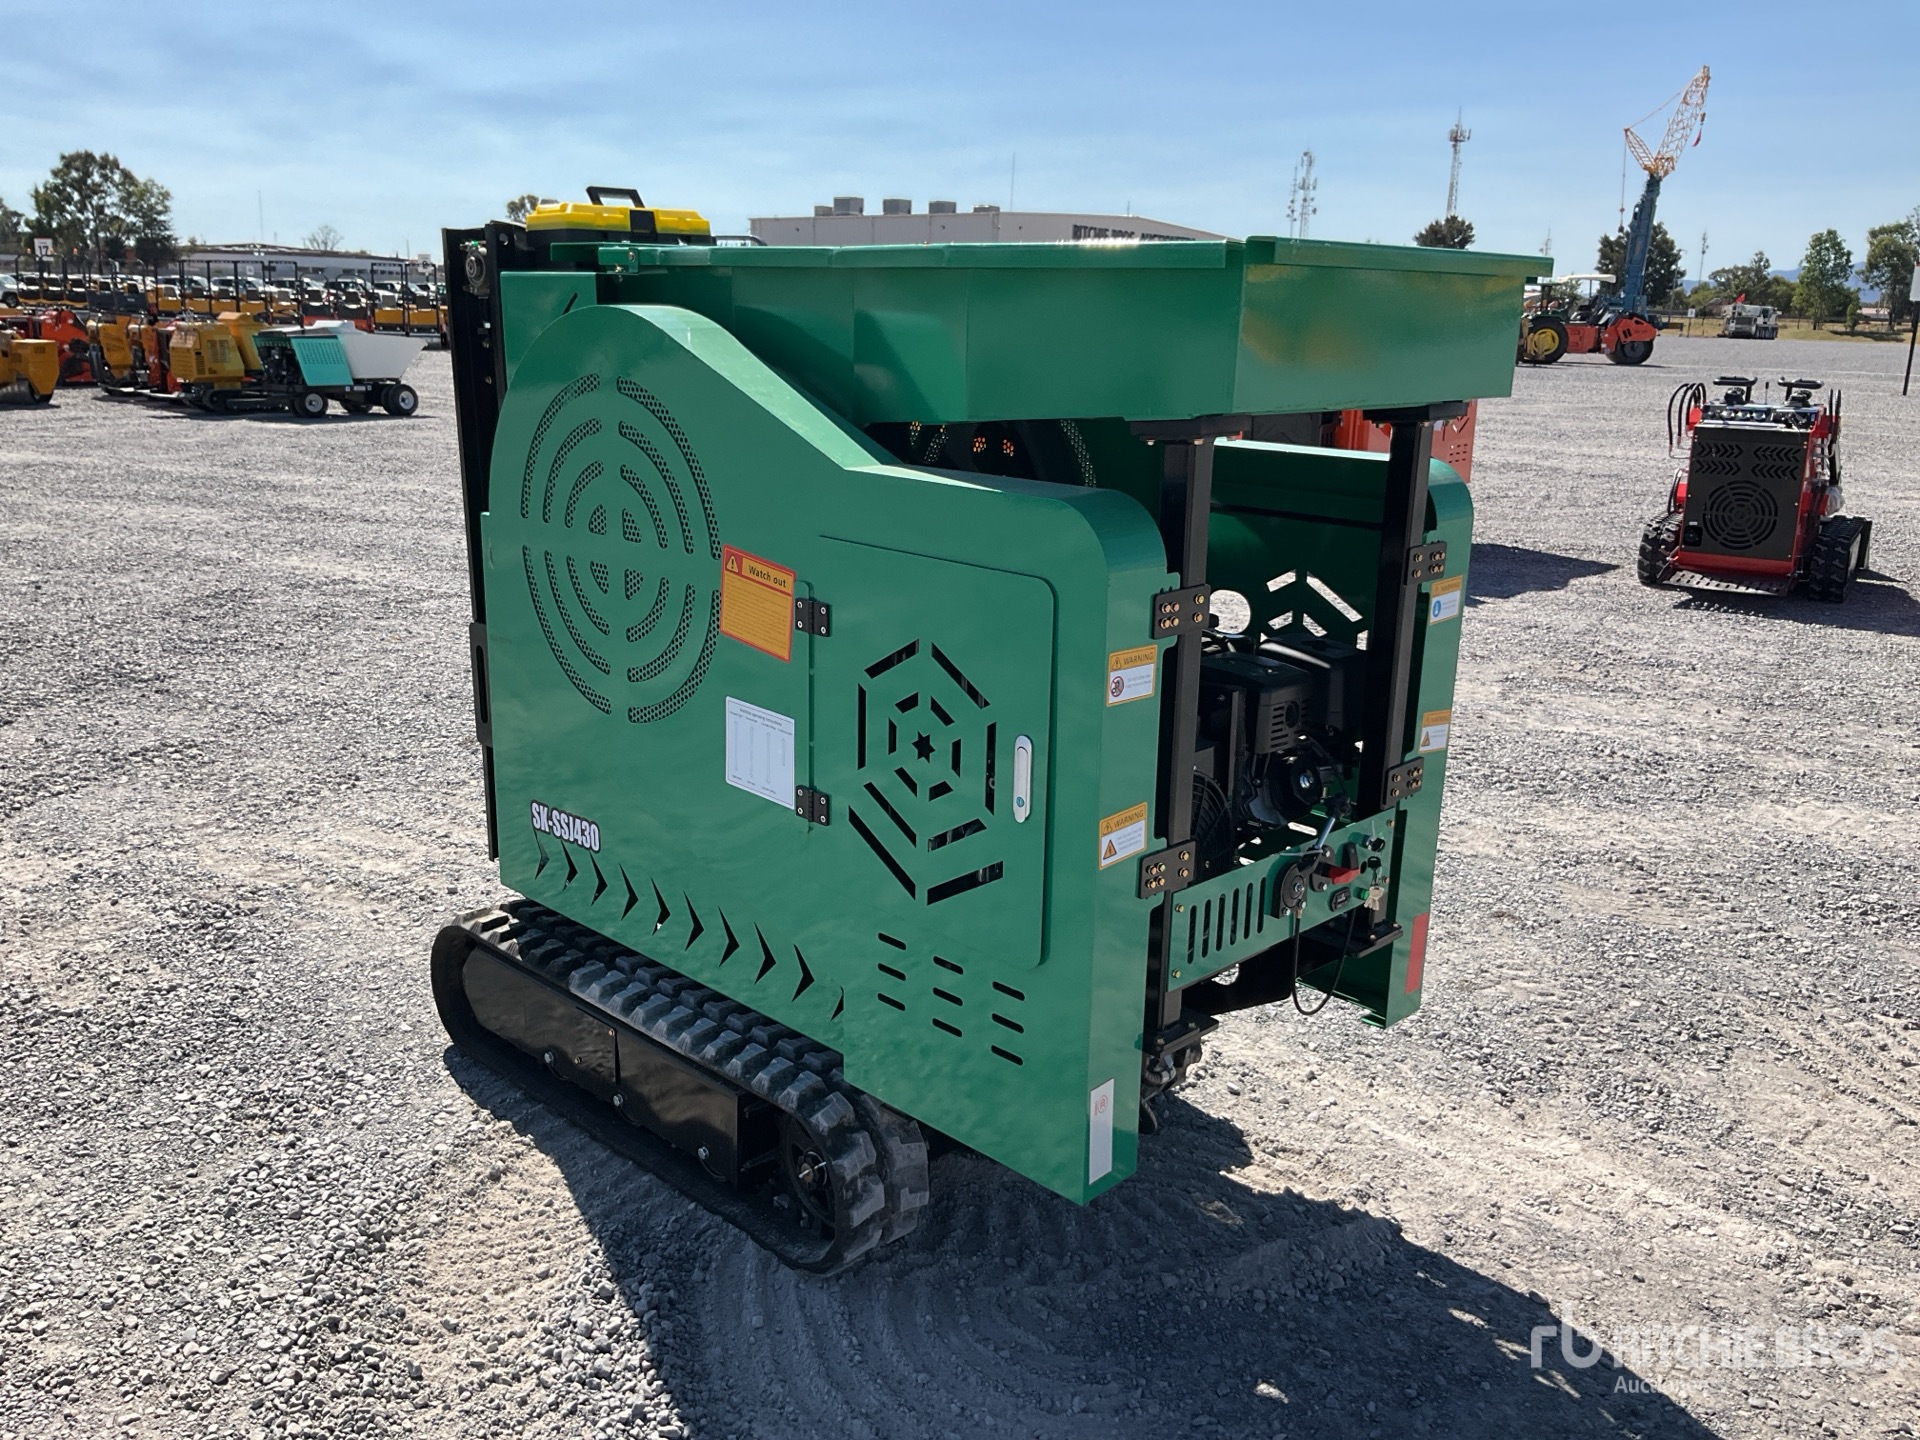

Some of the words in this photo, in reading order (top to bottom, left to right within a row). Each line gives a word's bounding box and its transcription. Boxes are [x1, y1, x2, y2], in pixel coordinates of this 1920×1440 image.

[38, 246, 49, 256] 17
[749, 565, 771, 581] Watch
[773, 578, 787, 588] out
[1124, 652, 1153, 665] WARNING
[1114, 809, 1144, 828] WARNING
